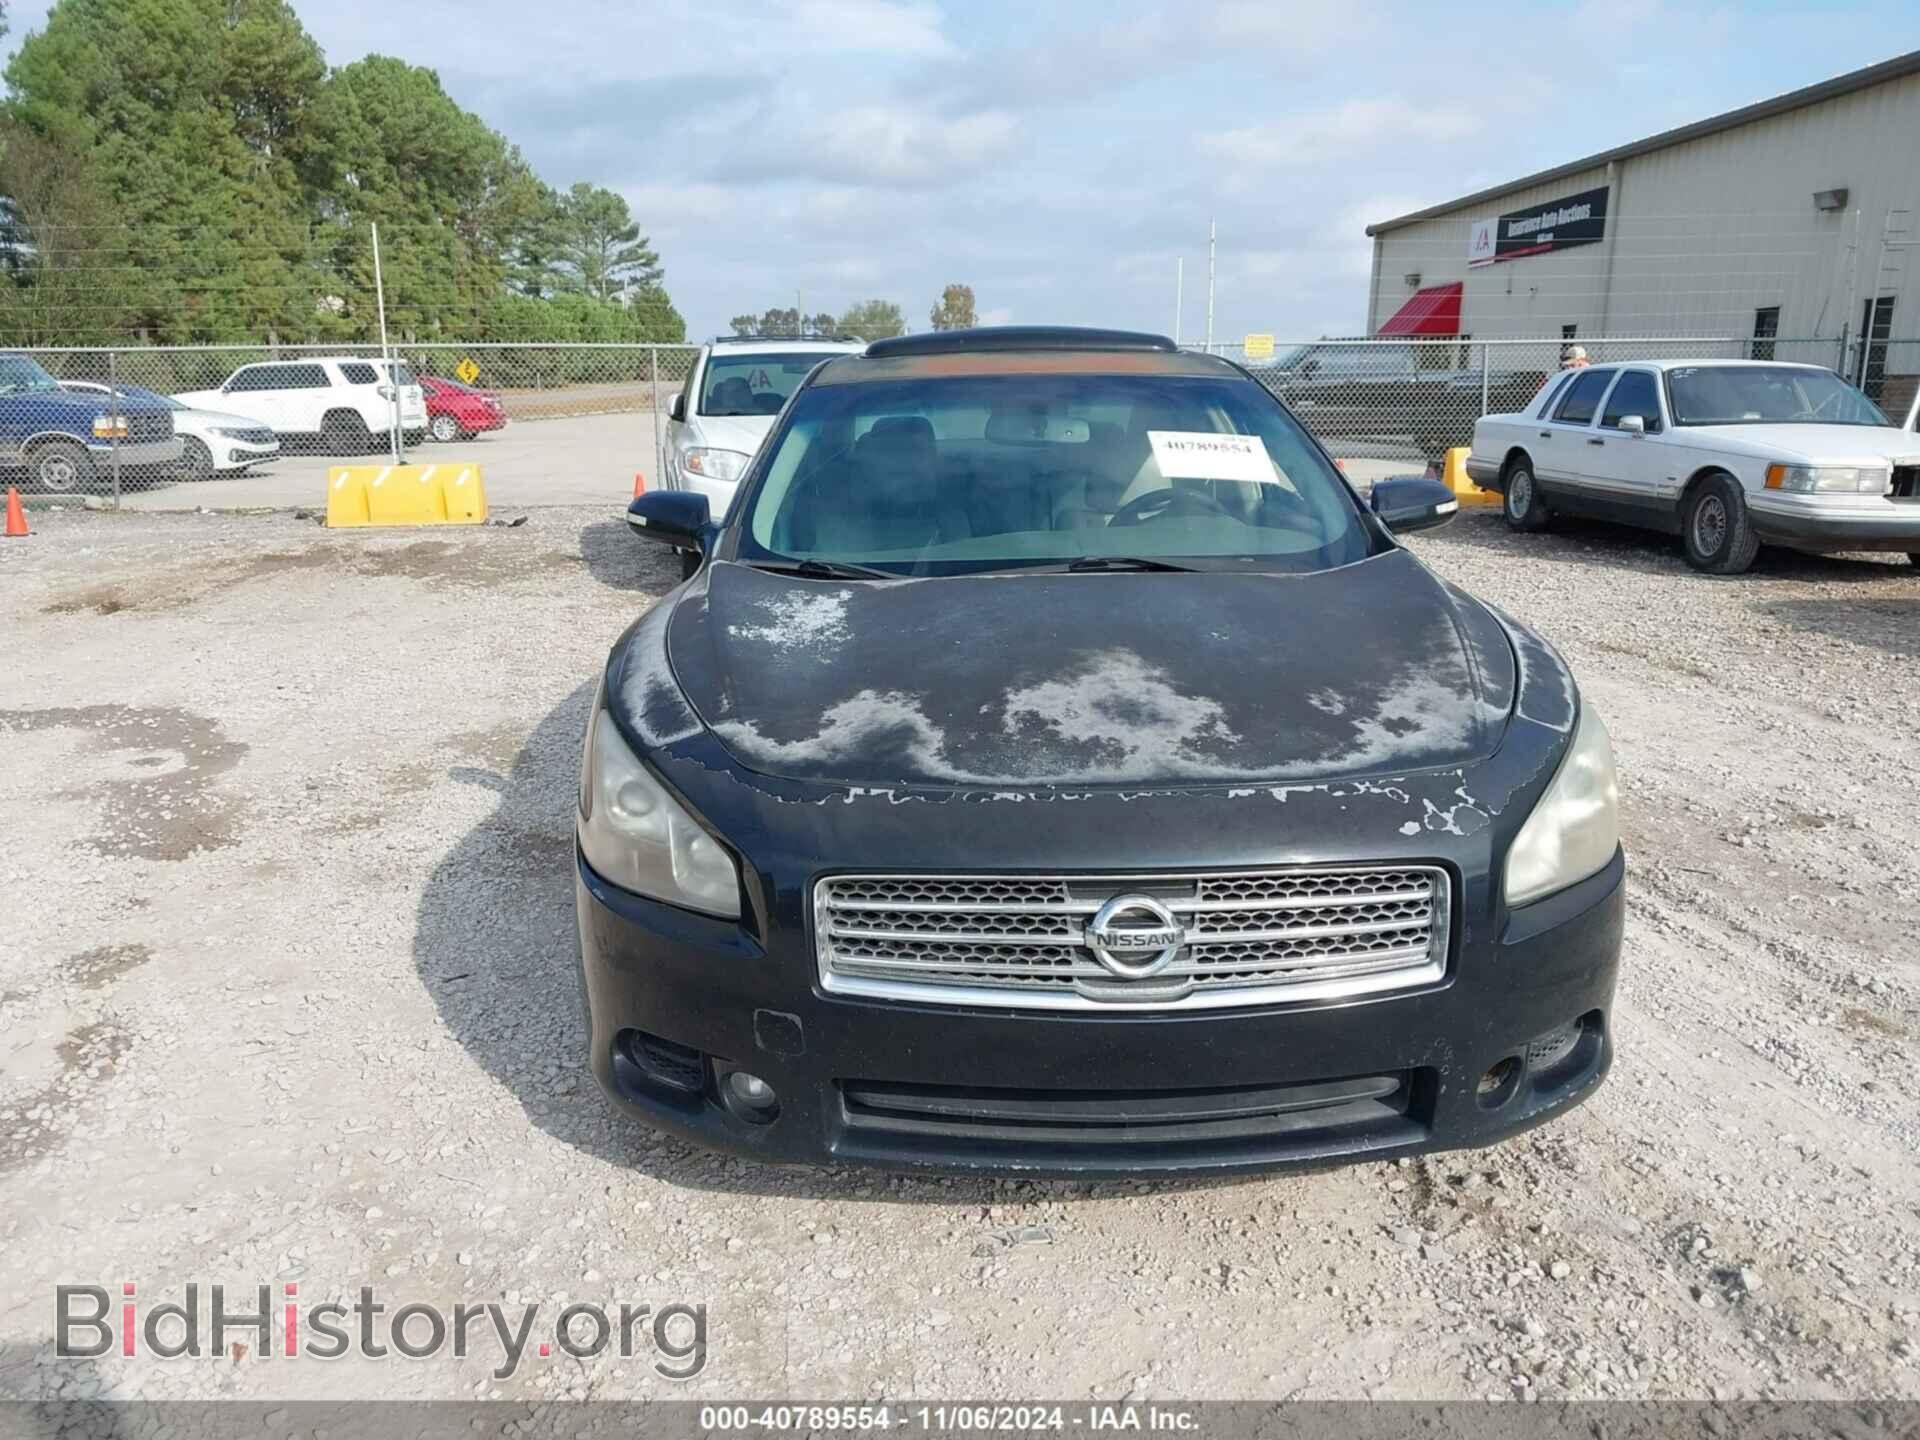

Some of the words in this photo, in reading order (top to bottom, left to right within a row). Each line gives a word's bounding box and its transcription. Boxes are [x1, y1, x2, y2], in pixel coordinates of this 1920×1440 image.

[1541, 211, 1558, 230] Auto
[1558, 203, 1591, 226] Auctions
[1097, 933, 1175, 946] NISSAN
